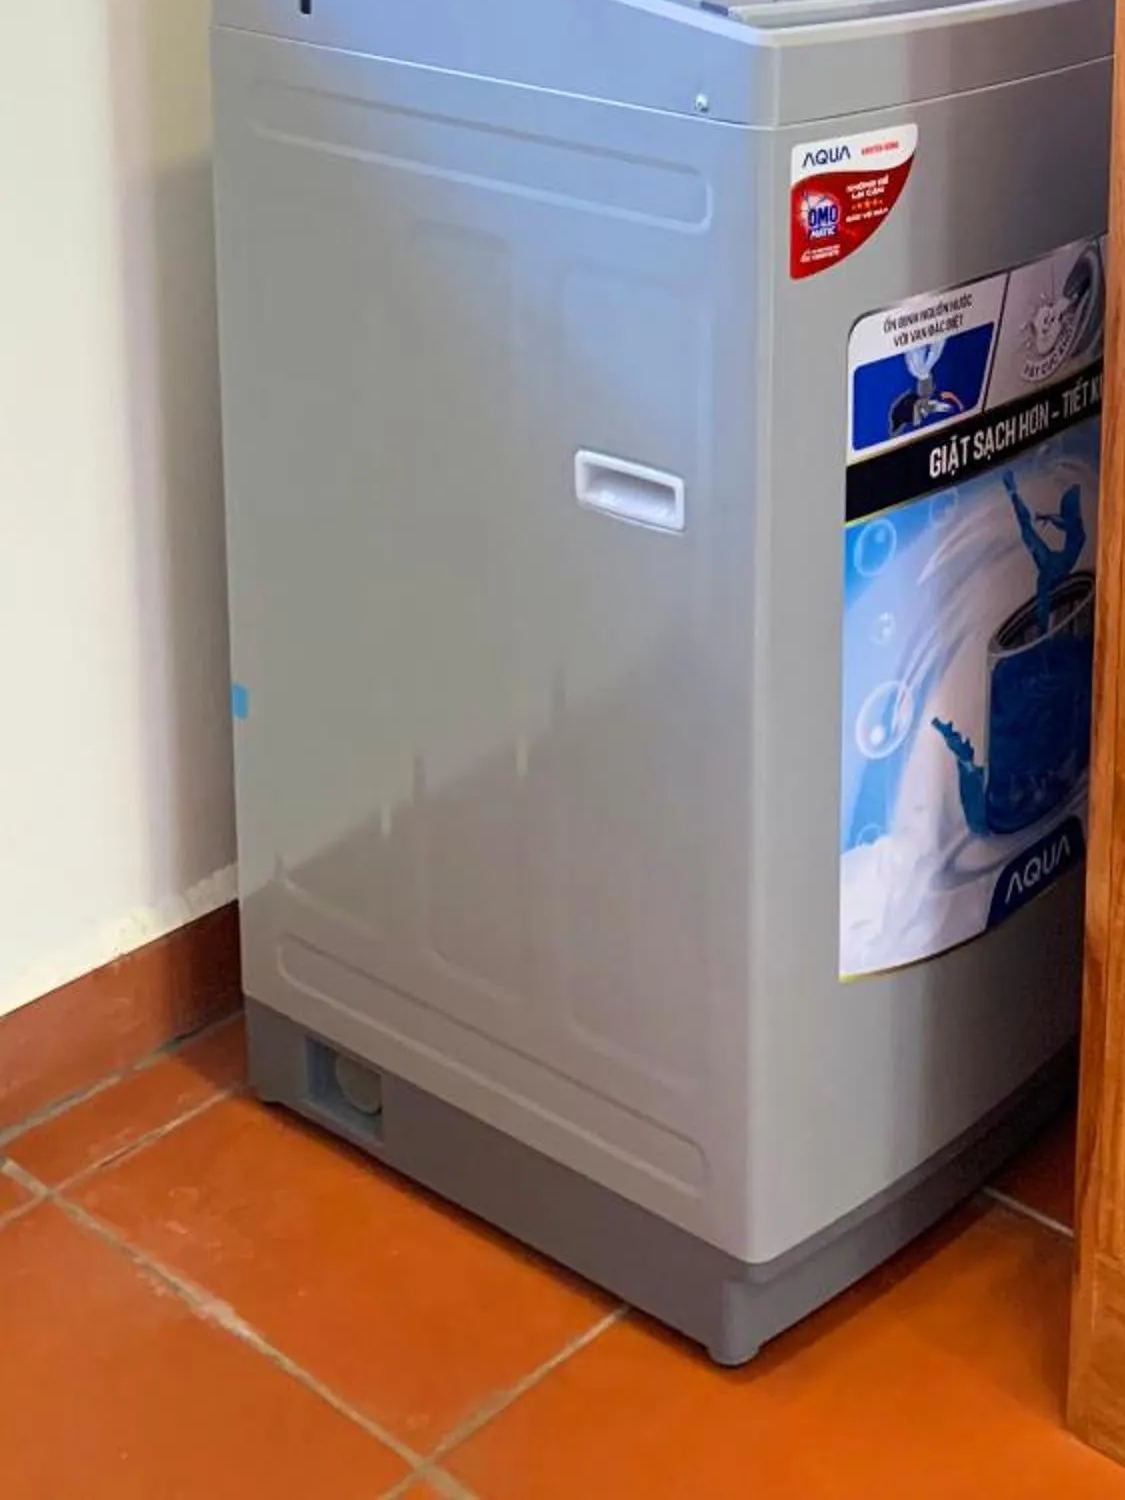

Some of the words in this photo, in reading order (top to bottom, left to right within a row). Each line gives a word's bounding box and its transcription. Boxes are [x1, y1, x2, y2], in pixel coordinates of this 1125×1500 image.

[802, 145, 851, 168] AQUA
[808, 205, 838, 227] OMO
[973, 415, 1017, 460] SẠCH
[1018, 401, 1050, 440] HƠN
[1004, 833, 1071, 904] AQUA
